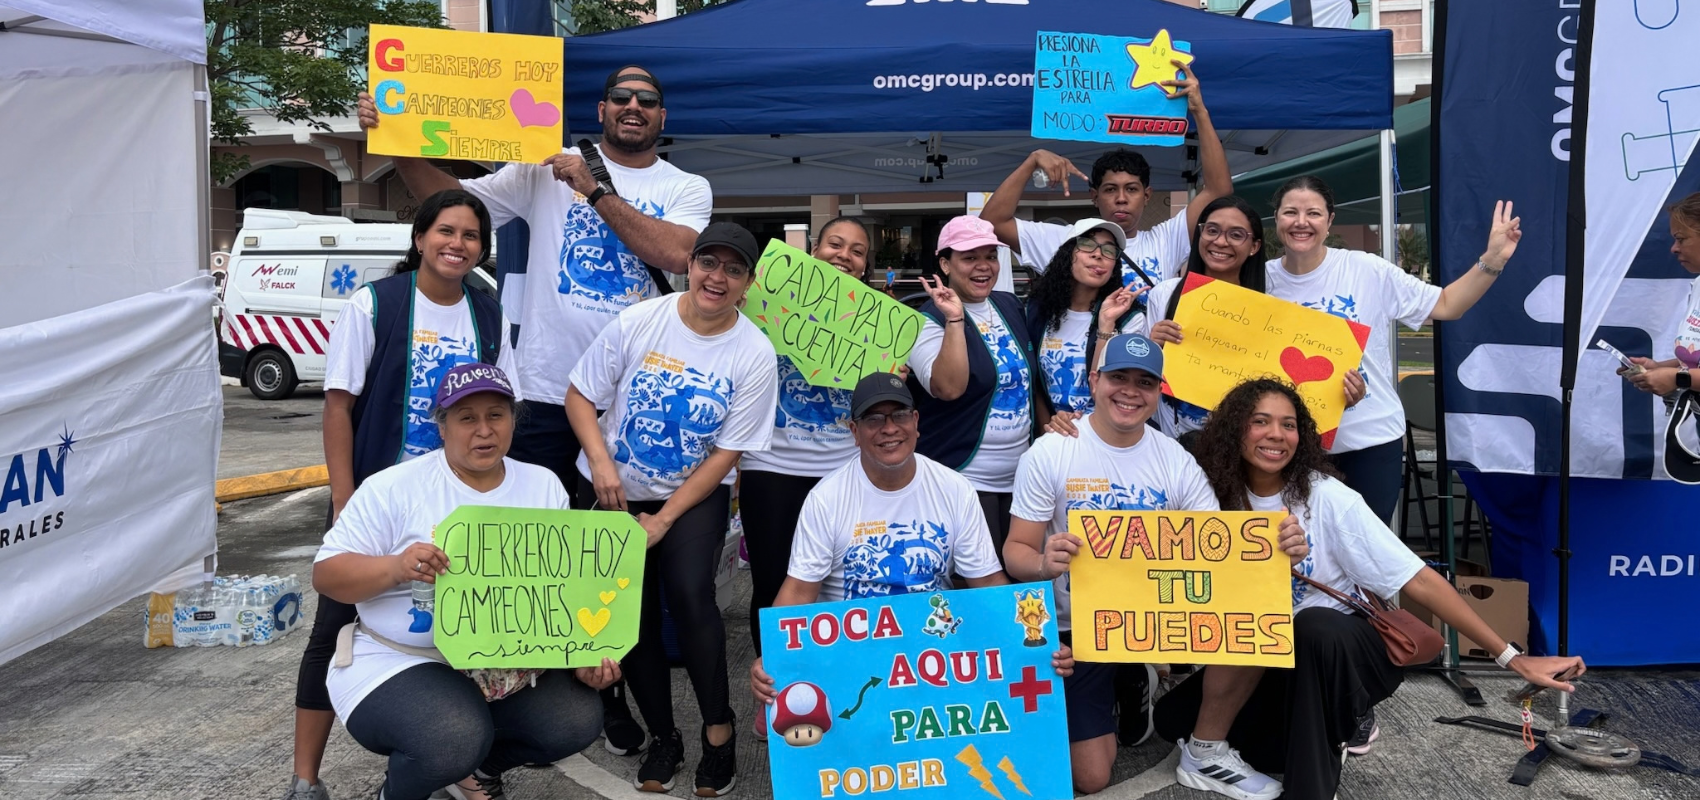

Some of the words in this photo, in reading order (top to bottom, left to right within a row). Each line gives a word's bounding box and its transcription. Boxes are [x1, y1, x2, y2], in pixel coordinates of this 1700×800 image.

[374, 38, 502, 79] GUERREROS
[514, 60, 559, 82] HOY
[1038, 35, 1101, 53] PRESIONA
[1063, 55, 1081, 67] LA
[374, 79, 506, 120] CAMPEONES
[873, 72, 1035, 92] omcgroup.com
[1038, 69, 1116, 92] ESTRELLA
[1060, 90, 1091, 104] PARA
[1044, 111, 1102, 133] MODO:
[1110, 117, 1187, 134] TURBO
[277, 265, 299, 276] emi
[764, 254, 840, 322] CADA
[849, 291, 920, 359] PASO
[1201, 293, 1250, 326] Cuando
[1262, 315, 1283, 335] las
[783, 312, 867, 381] CUENTA
[443, 522, 572, 579] GUERREROS
[579, 528, 631, 579] HOY
[1081, 516, 1273, 562] VAMOS
[1608, 555, 1695, 577] RADI
[1148, 569, 1212, 604] TU
[152, 613, 170, 624] 40
[208, 623, 232, 631] WATER
[440, 583, 573, 638] CAMPEONES
[779, 605, 903, 650] TOCA
[468, 639, 625, 666] siempre
[1094, 610, 1293, 655] PUEDES
[888, 648, 1004, 688] AQUI
[890, 700, 1010, 744] PARA
[818, 758, 948, 798] PODER
